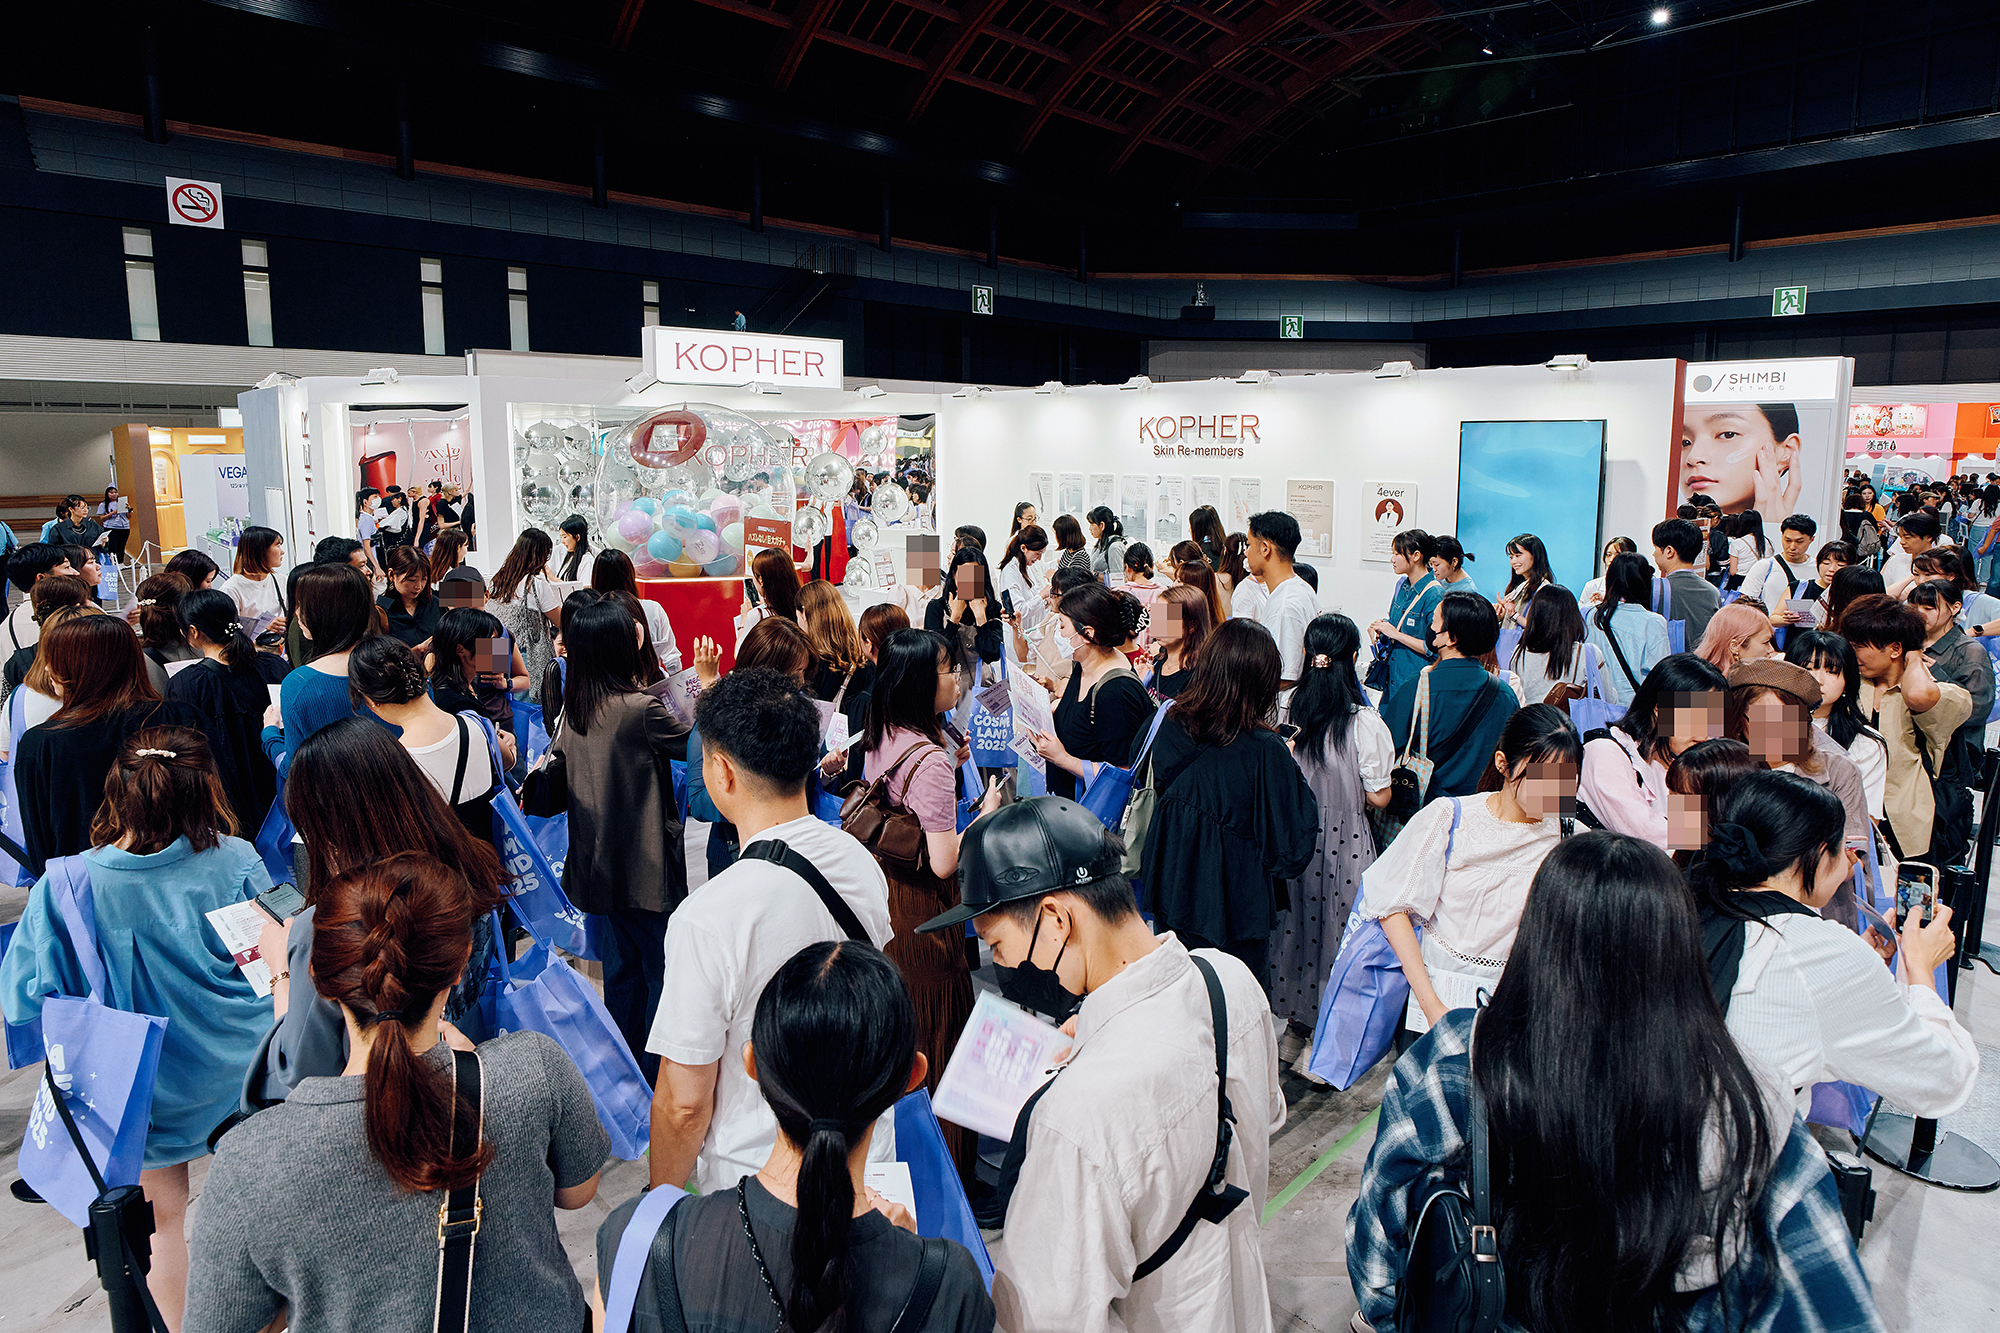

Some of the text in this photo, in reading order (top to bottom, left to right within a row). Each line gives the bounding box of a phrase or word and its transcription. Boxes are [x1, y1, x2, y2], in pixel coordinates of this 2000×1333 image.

[674, 342, 825, 377] KOPHER
[1729, 372, 1786, 384] SHIMBI
[1139, 414, 1260, 439] KOPHER
[1153, 445, 1244, 457] Skin Re-members
[1377, 487, 1404, 497] 4ever
[973, 714, 1011, 728] COSME
[976, 727, 1008, 740] LAND
[976, 739, 1007, 751] 2025
